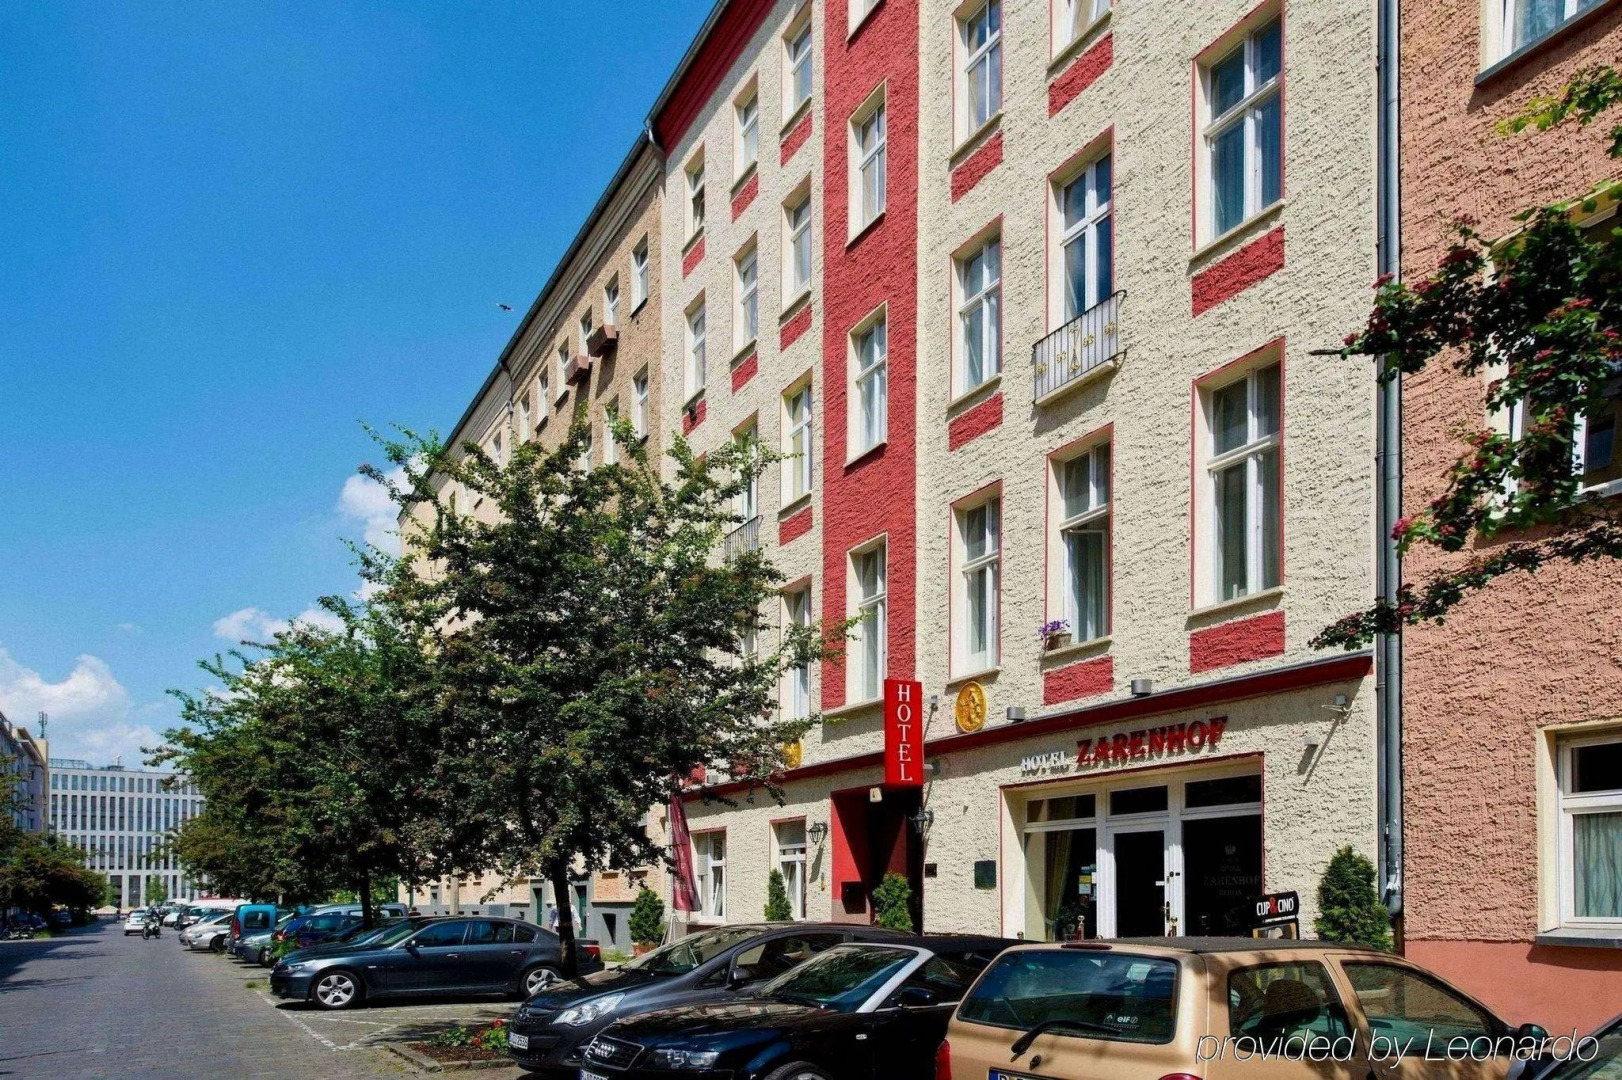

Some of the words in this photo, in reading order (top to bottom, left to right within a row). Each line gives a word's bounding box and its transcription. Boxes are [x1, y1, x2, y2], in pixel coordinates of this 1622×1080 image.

[897, 684, 913, 781] HOTEL
[1021, 751, 1067, 771] HOTEL
[1077, 716, 1228, 765] ZARENHOF
